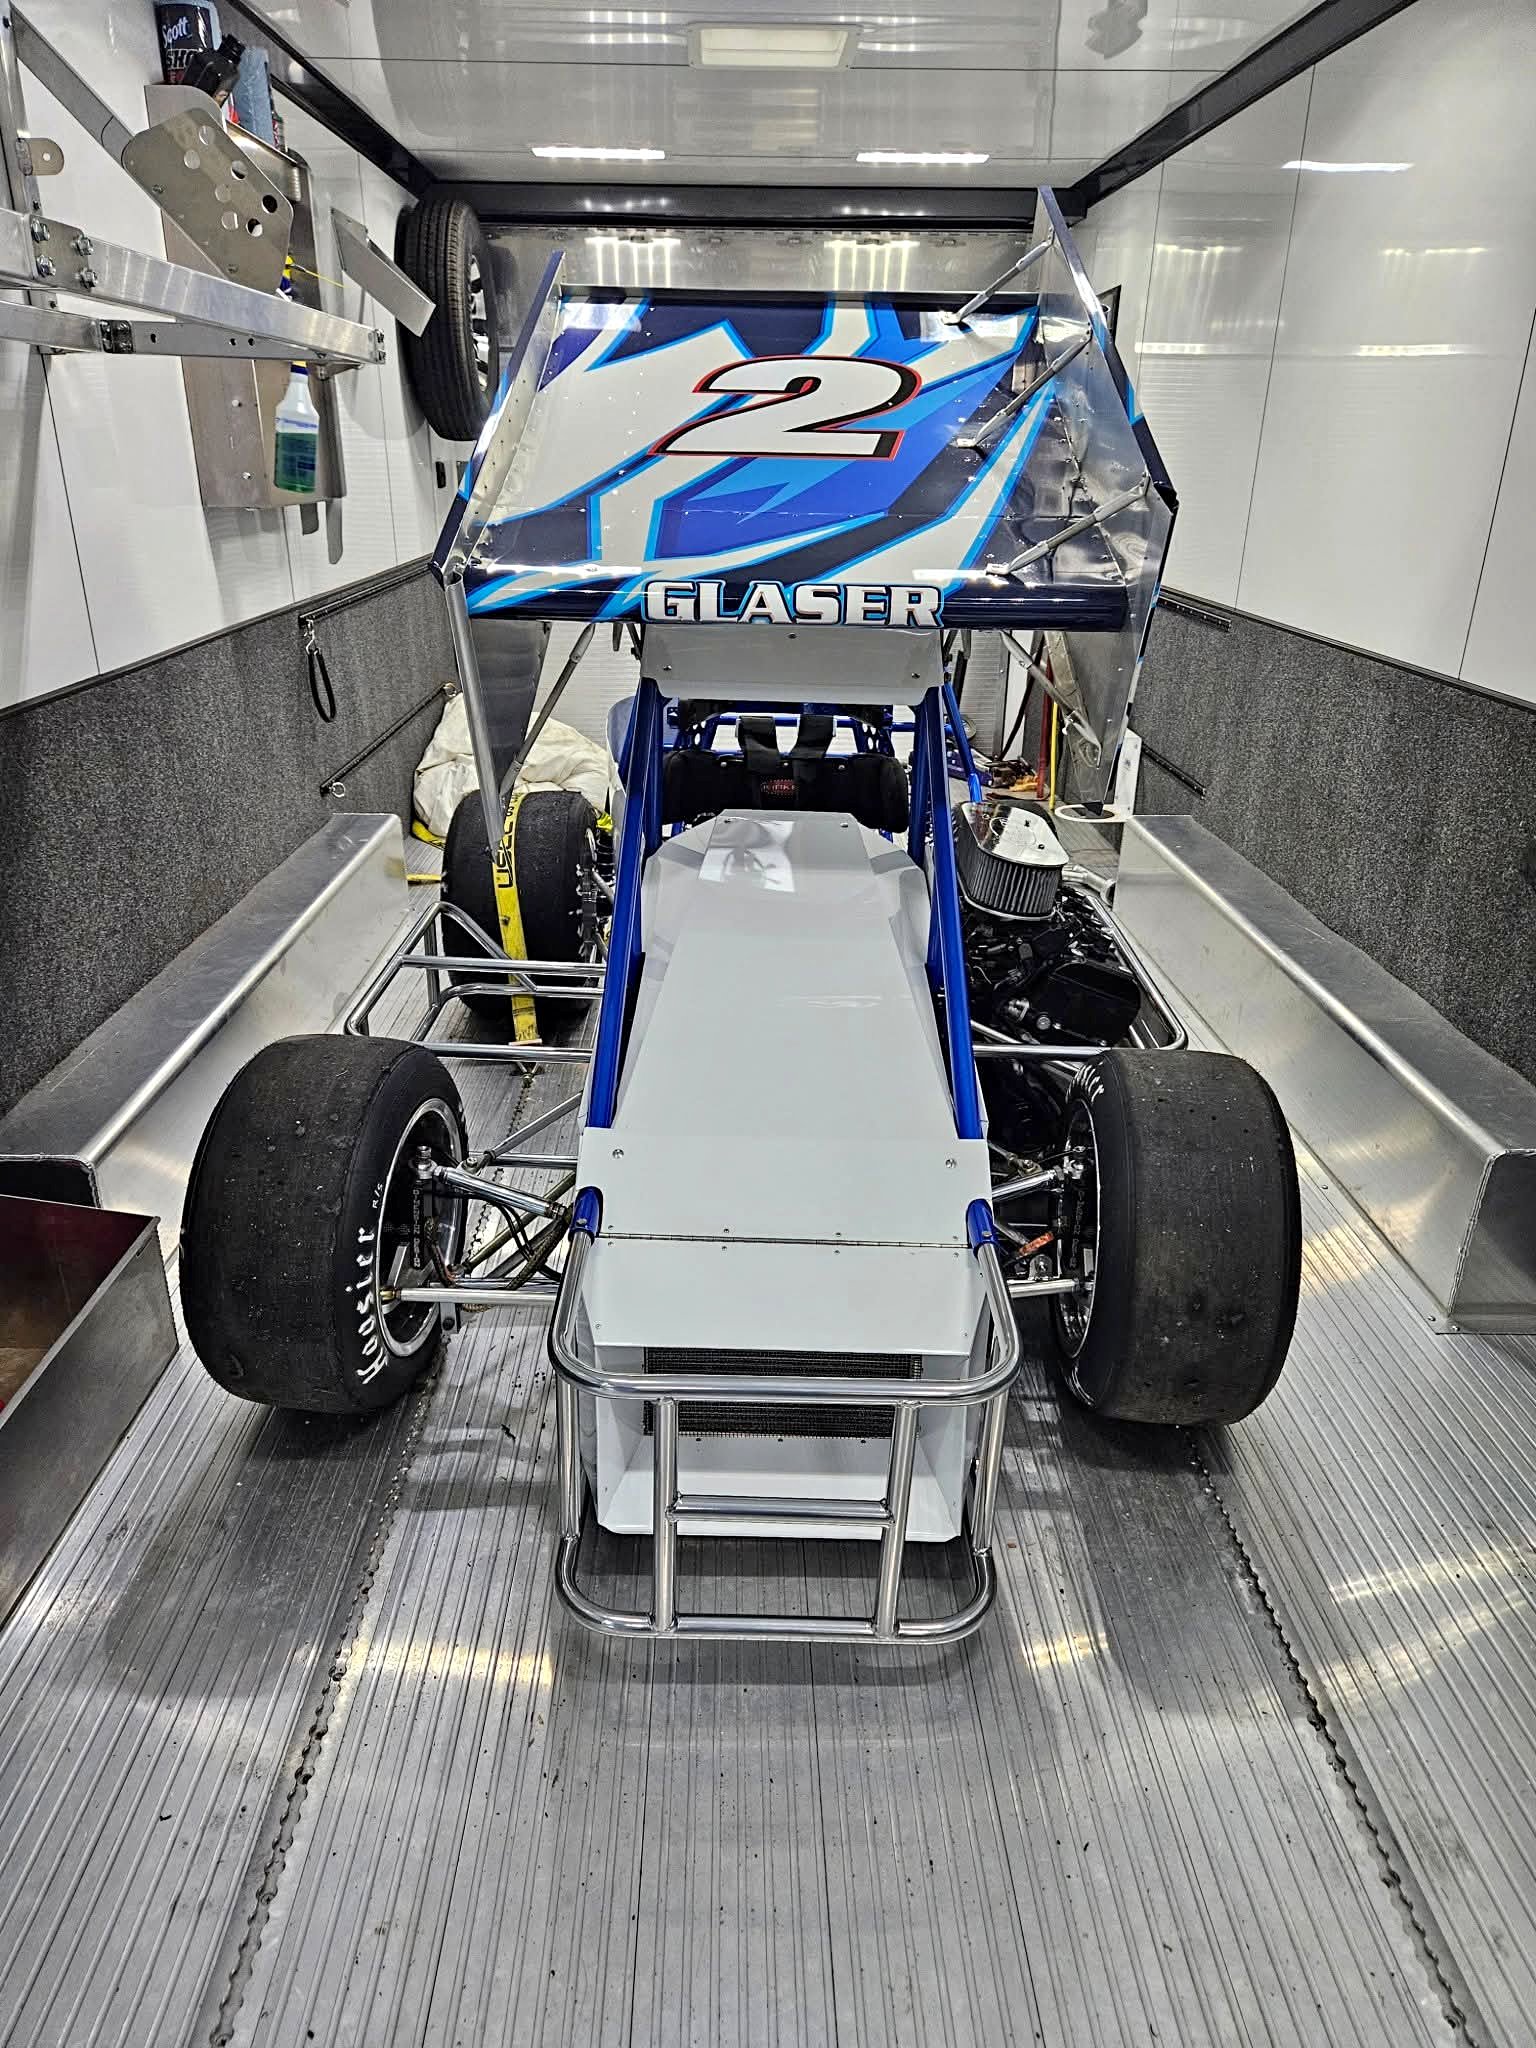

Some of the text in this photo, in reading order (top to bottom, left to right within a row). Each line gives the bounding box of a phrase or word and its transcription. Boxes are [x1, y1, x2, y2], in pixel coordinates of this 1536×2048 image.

[162, 16, 188, 48] Scott
[166, 48, 197, 69] SHO
[647, 354, 922, 461] 2
[642, 579, 945, 627] GLASER
[345, 1227, 388, 1384] Hoosier
